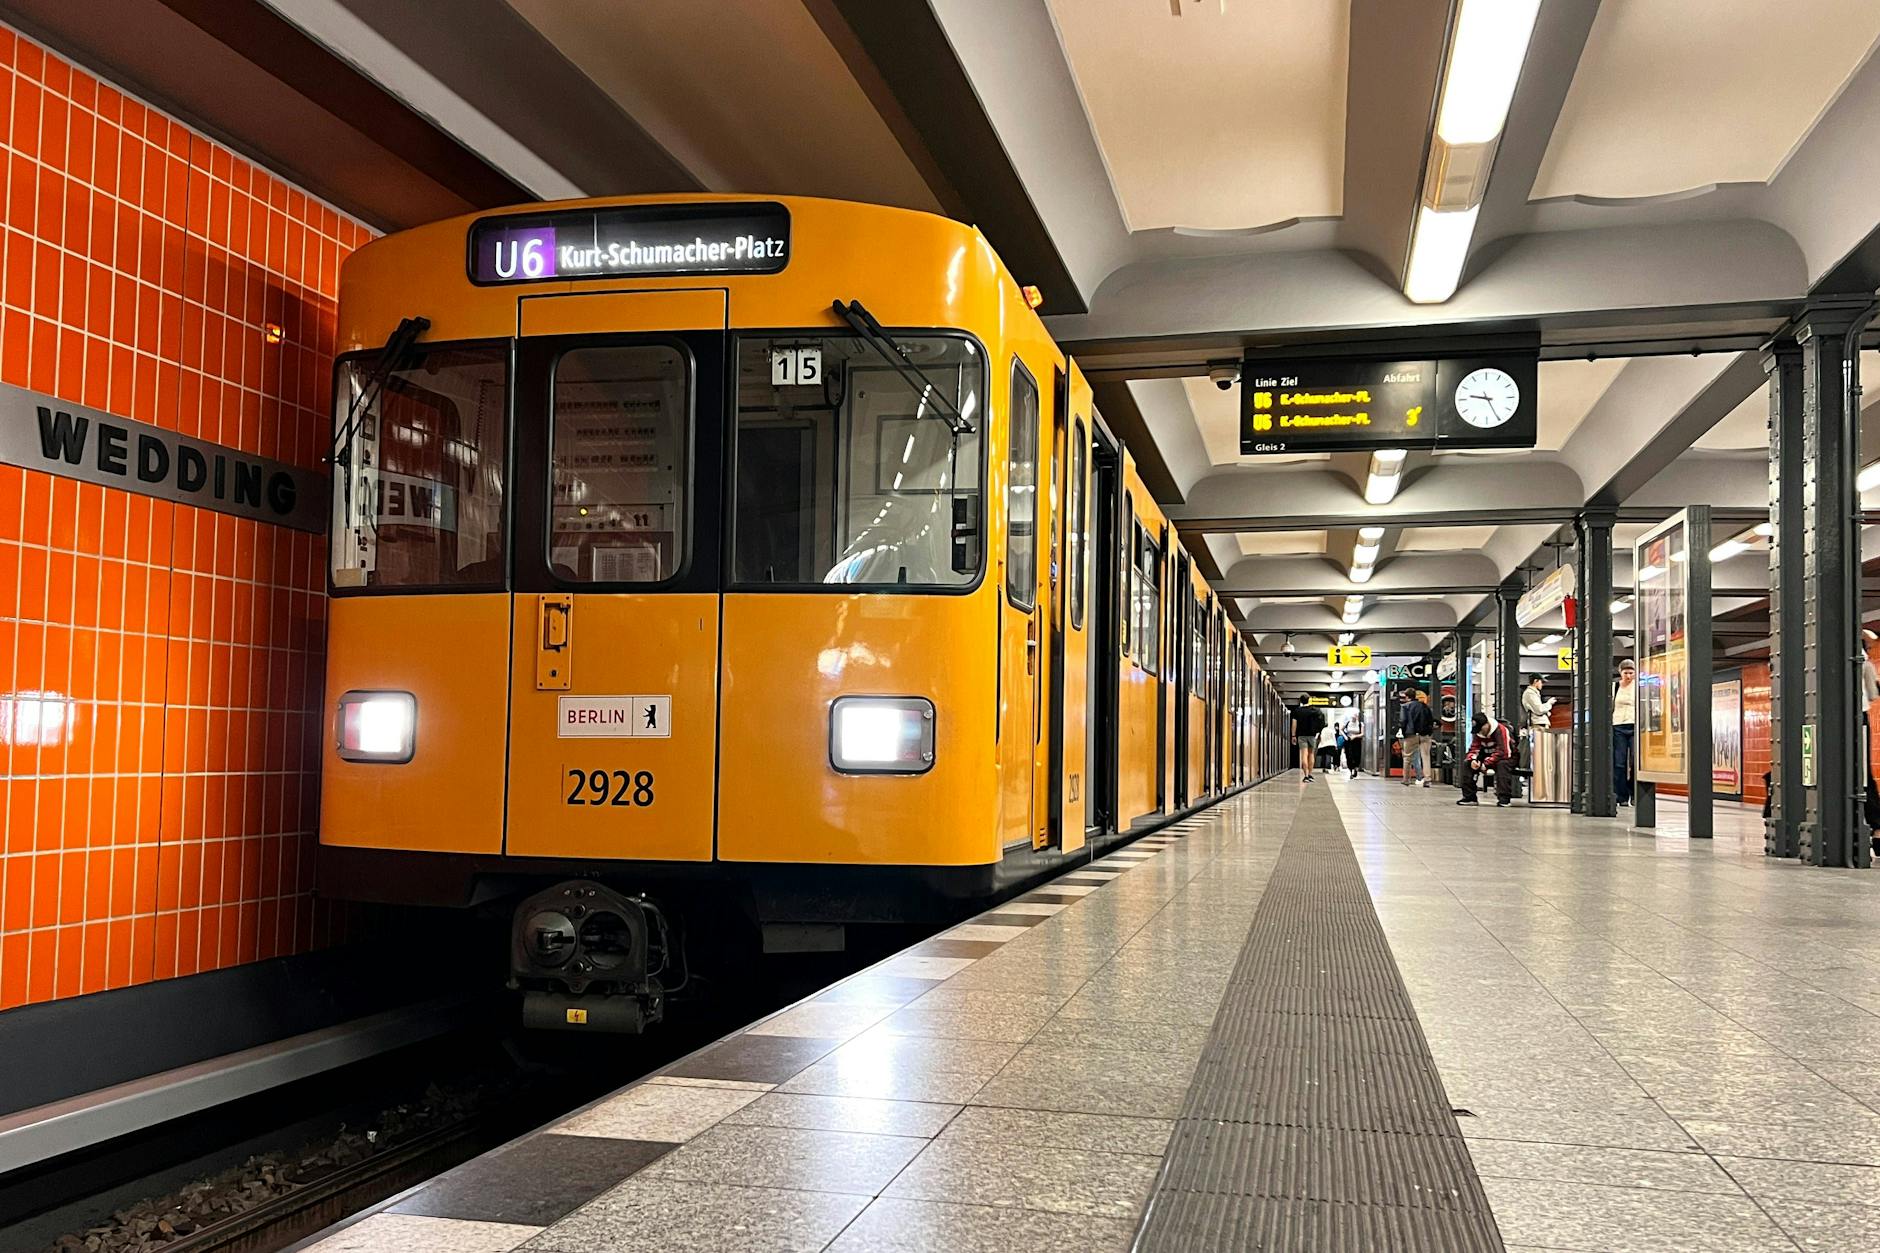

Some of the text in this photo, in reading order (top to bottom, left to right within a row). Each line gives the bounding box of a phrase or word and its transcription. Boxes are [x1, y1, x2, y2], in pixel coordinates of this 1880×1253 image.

[494, 235, 785, 278] U6 Kurt-Schumacher-Platz
[777, 357, 817, 380] 15
[1255, 373, 1421, 388] Linie Ziel Abfahrt
[1255, 443, 1286, 452] Gleis 2
[36, 406, 297, 516] WEDDING
[567, 709, 625, 724] BERLIN
[567, 768, 655, 807] 2928
